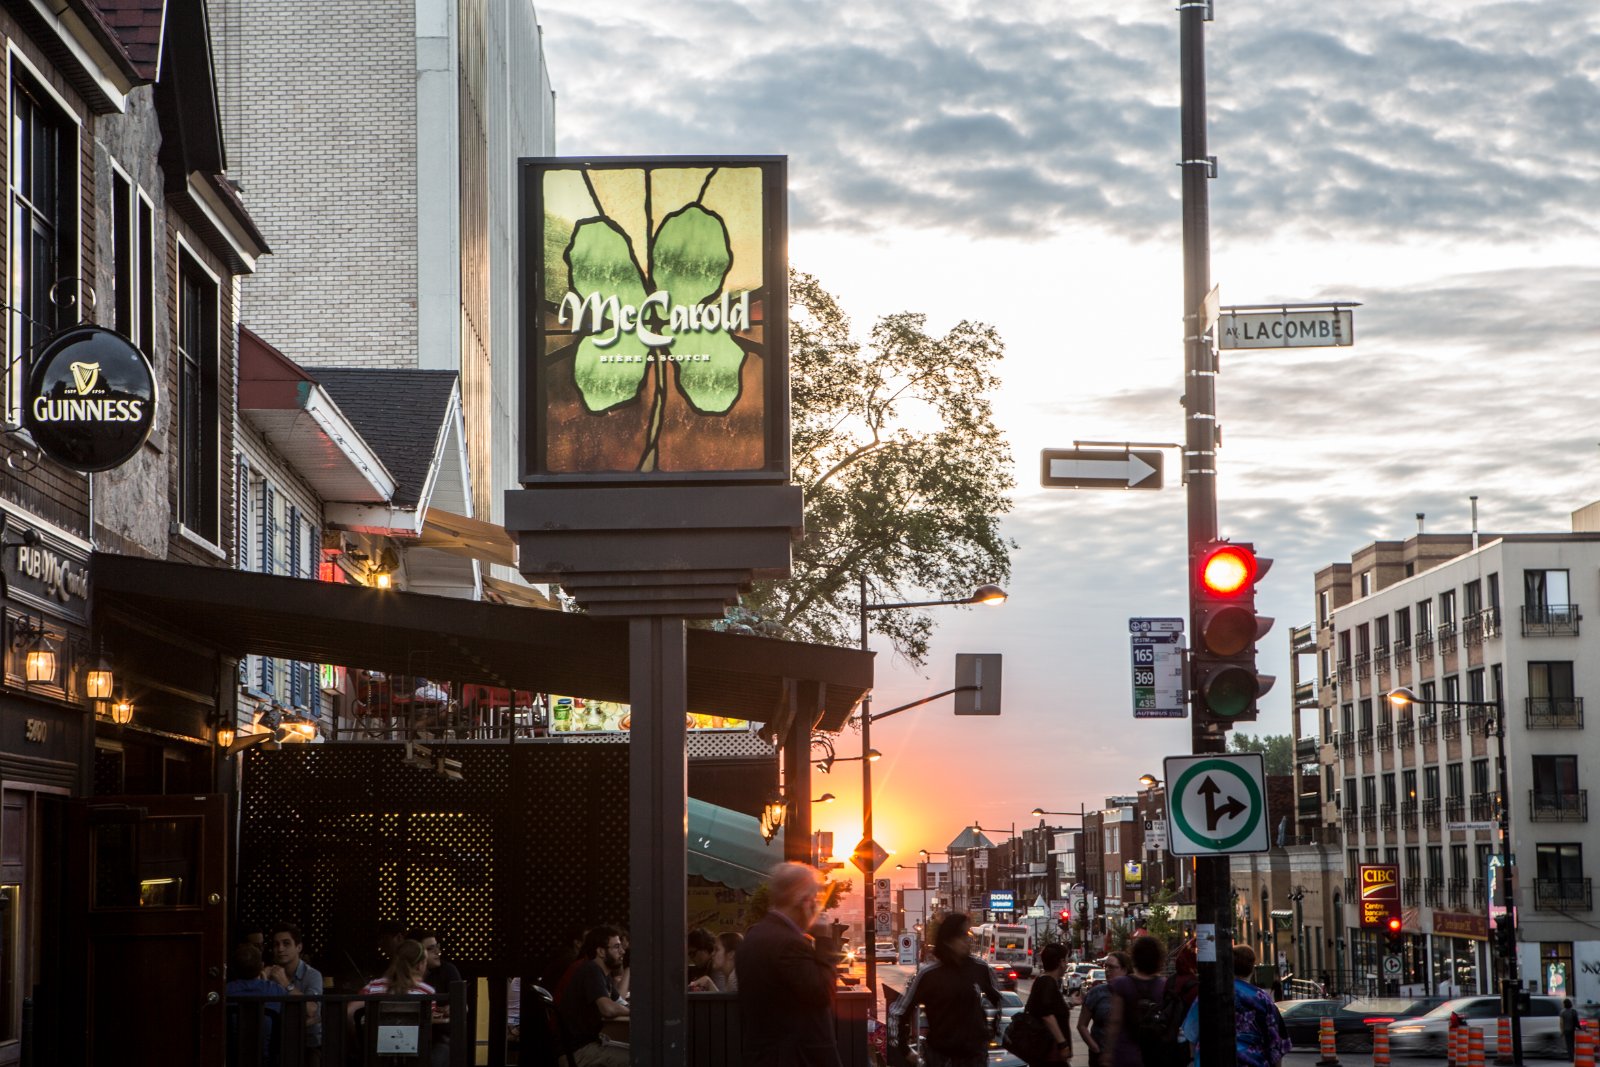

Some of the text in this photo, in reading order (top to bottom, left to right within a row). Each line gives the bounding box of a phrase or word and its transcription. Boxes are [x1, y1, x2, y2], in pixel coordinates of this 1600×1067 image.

[558, 291, 750, 346] McCarold
[1243, 320, 1341, 340] LACOMBE
[33, 396, 143, 422] GUINNESS
[18, 546, 41, 579] PUB
[1135, 649, 1153, 662] 165
[1135, 672, 1154, 685] 369
[1139, 699, 1155, 708] 435
[1364, 869, 1394, 882] CIBC
